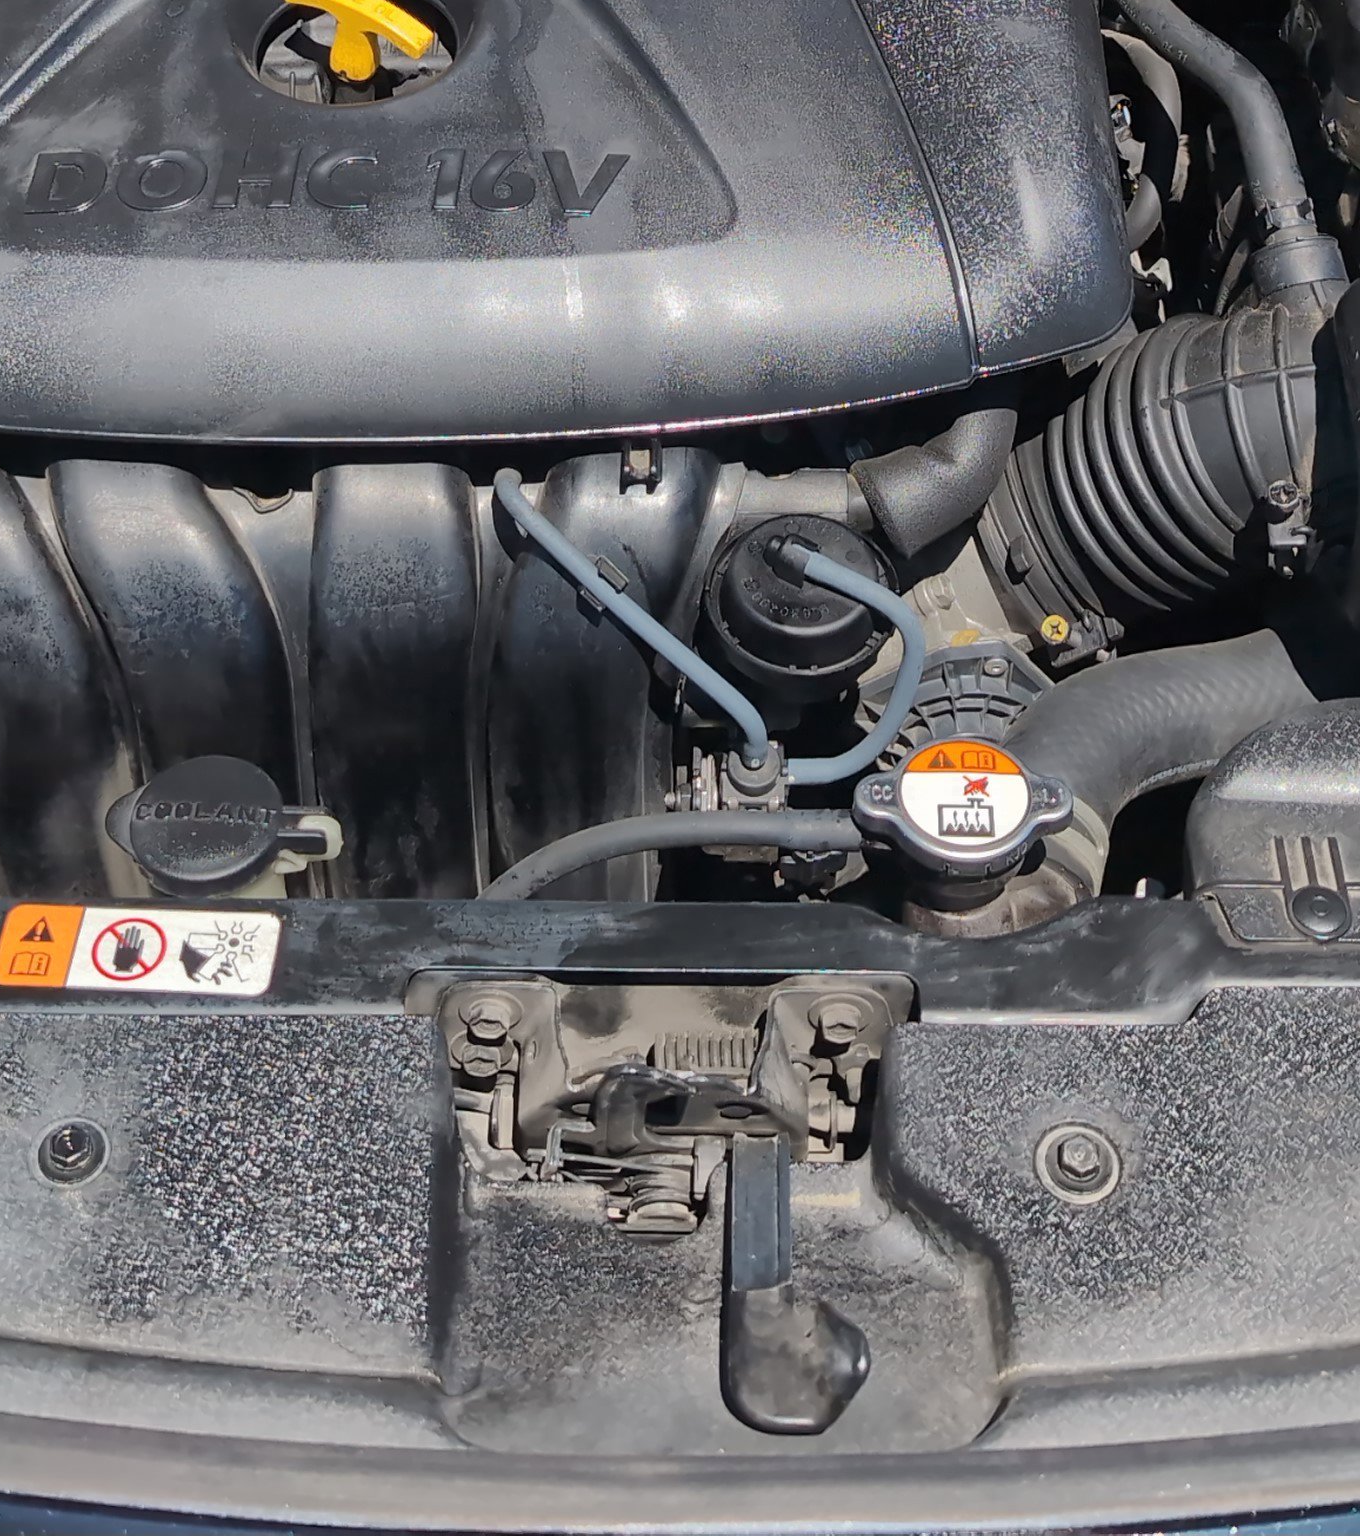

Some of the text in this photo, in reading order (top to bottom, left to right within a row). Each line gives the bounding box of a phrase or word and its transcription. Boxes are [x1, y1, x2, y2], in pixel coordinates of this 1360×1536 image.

[24, 147, 632, 219] DOHC 16V
[135, 801, 277, 828] COOLANT
